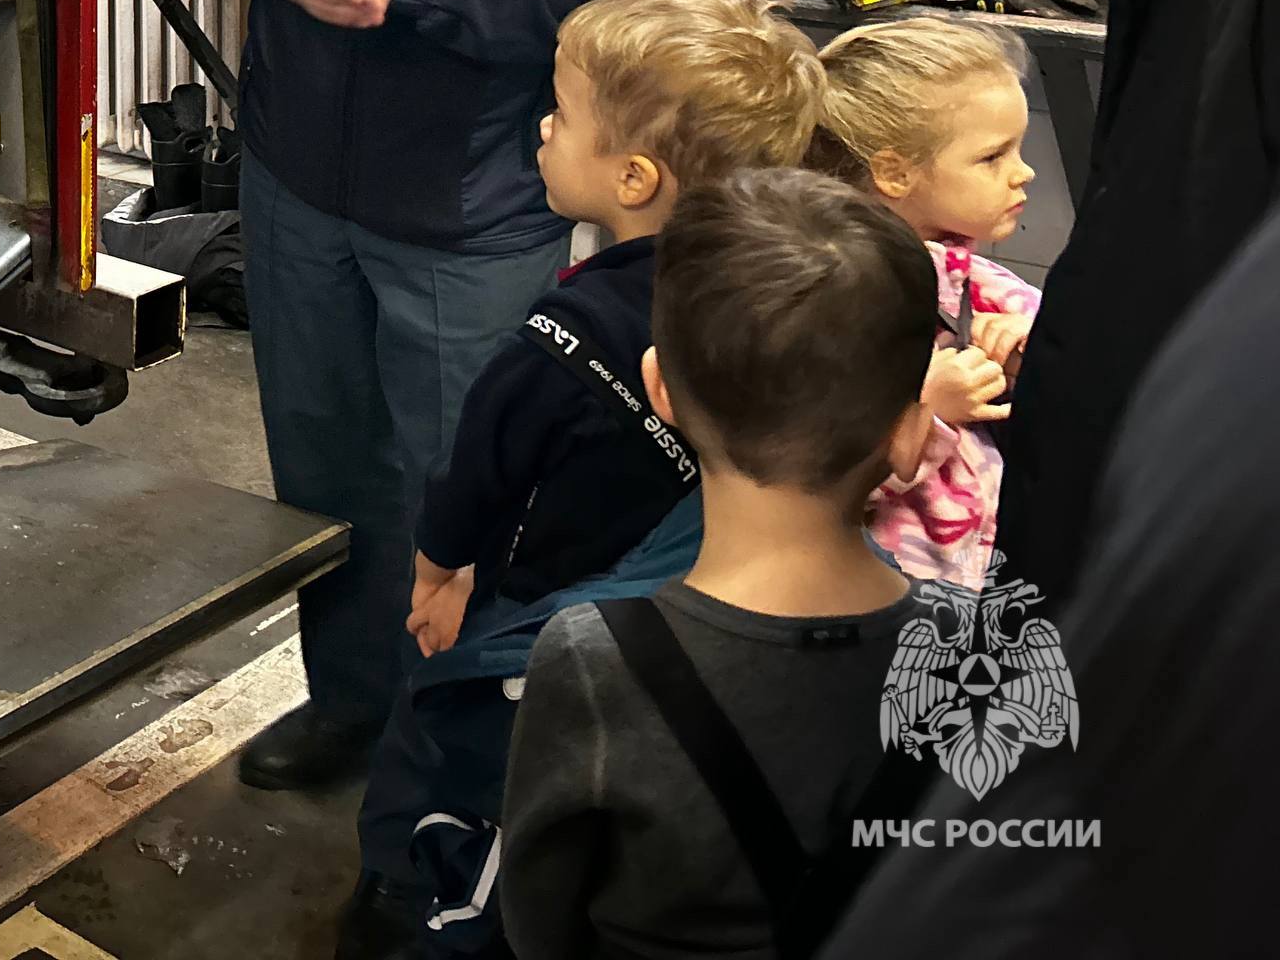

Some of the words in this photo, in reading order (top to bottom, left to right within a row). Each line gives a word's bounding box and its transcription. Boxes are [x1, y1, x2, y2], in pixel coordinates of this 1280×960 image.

[588, 359, 614, 382] 1949
[612, 380, 642, 412] since
[644, 415, 696, 482] Lassie
